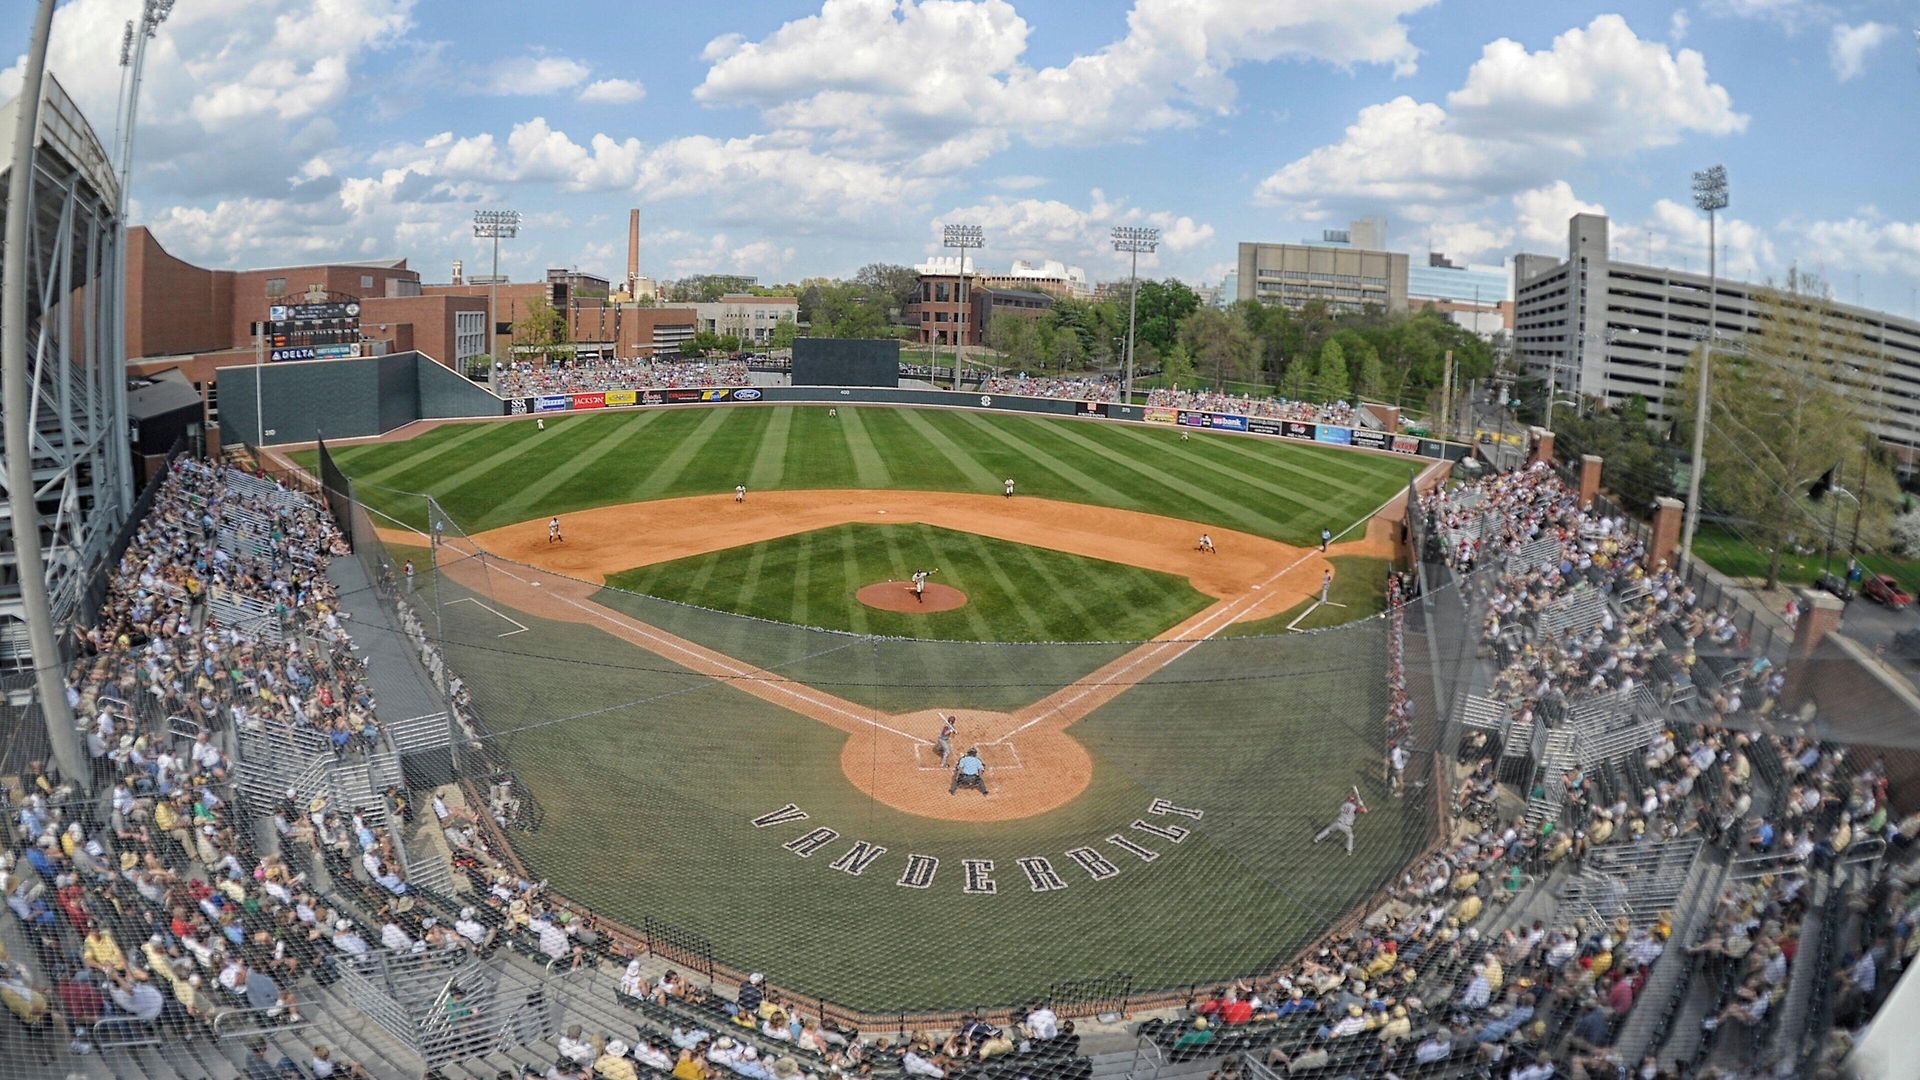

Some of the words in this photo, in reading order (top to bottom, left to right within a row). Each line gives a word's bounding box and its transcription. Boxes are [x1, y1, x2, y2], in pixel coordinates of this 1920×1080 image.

[282, 349, 314, 359] DELTA
[574, 396, 604, 406] JACKSON
[751, 797, 1203, 894] VANDERBILT
